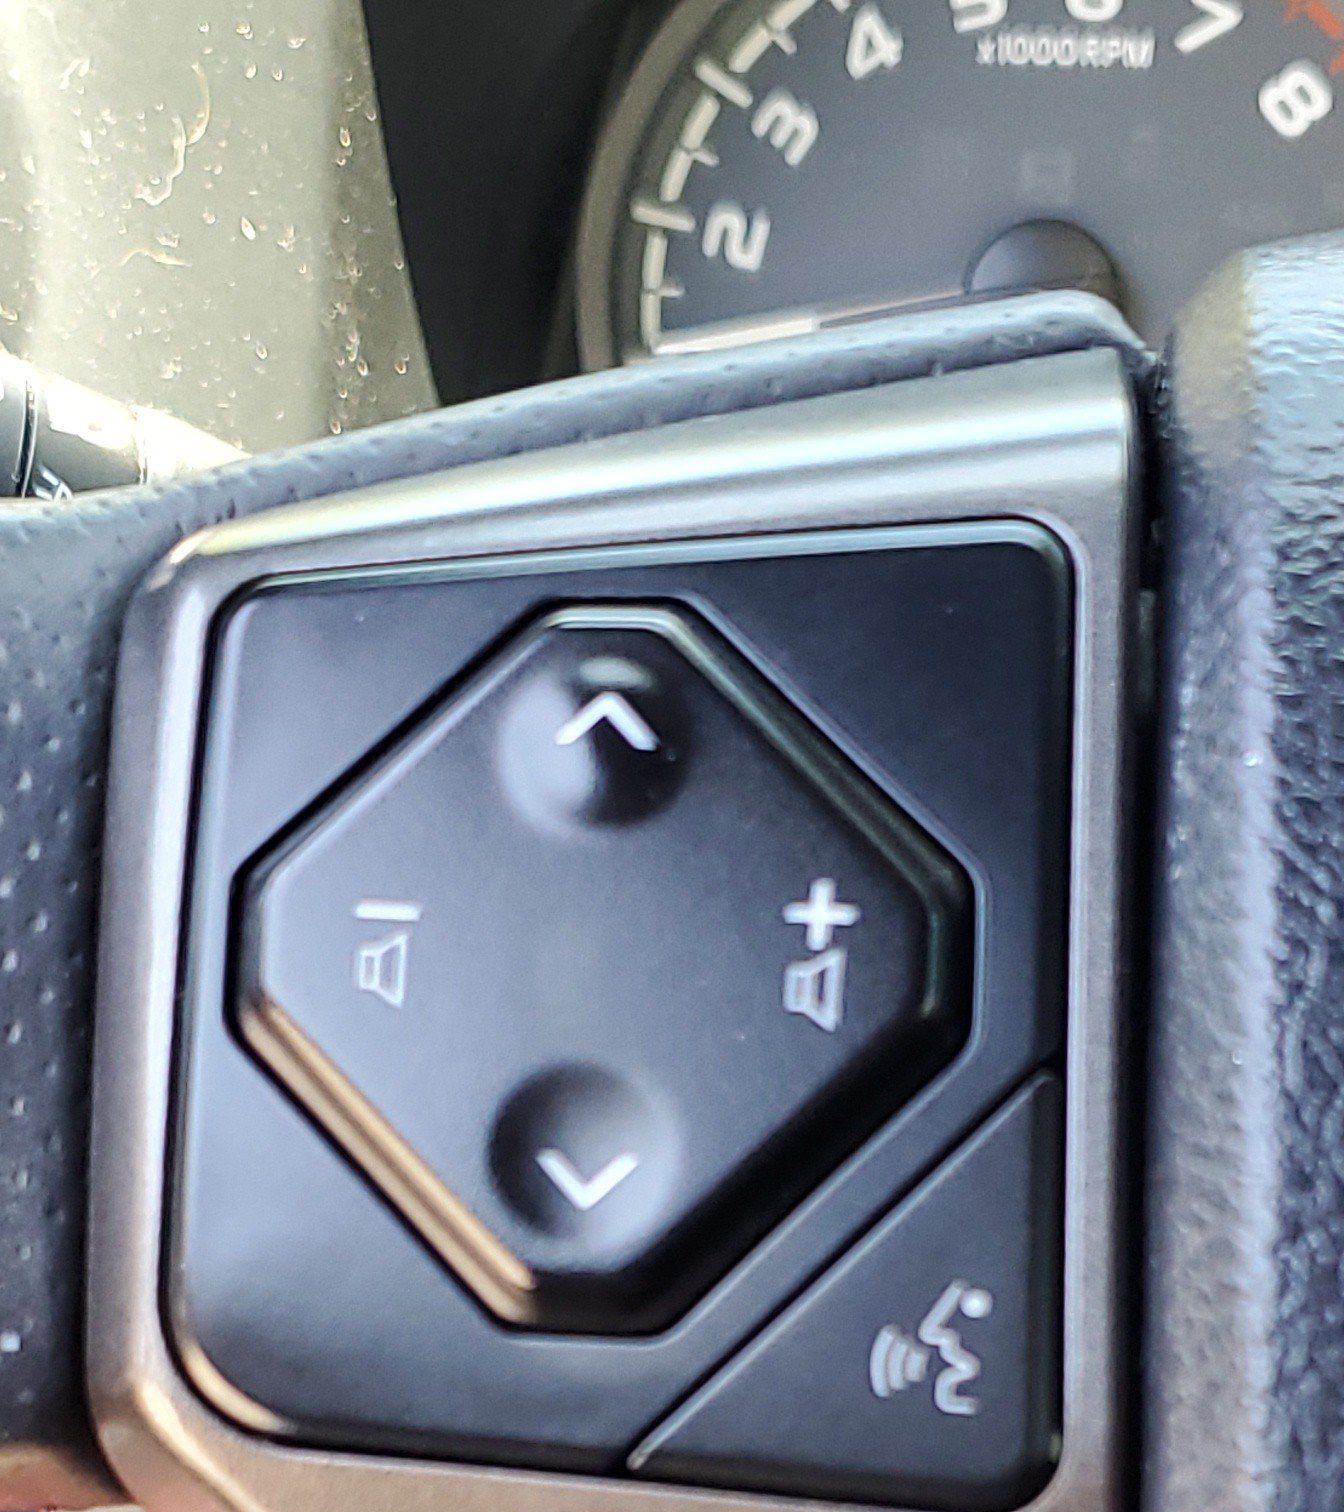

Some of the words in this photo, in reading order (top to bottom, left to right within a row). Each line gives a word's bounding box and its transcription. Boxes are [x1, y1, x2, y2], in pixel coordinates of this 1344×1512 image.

[845, 3, 904, 80] 4
[751, 88, 820, 166] 3
[1258, 59, 1334, 139] 8
[702, 199, 771, 271] 2
